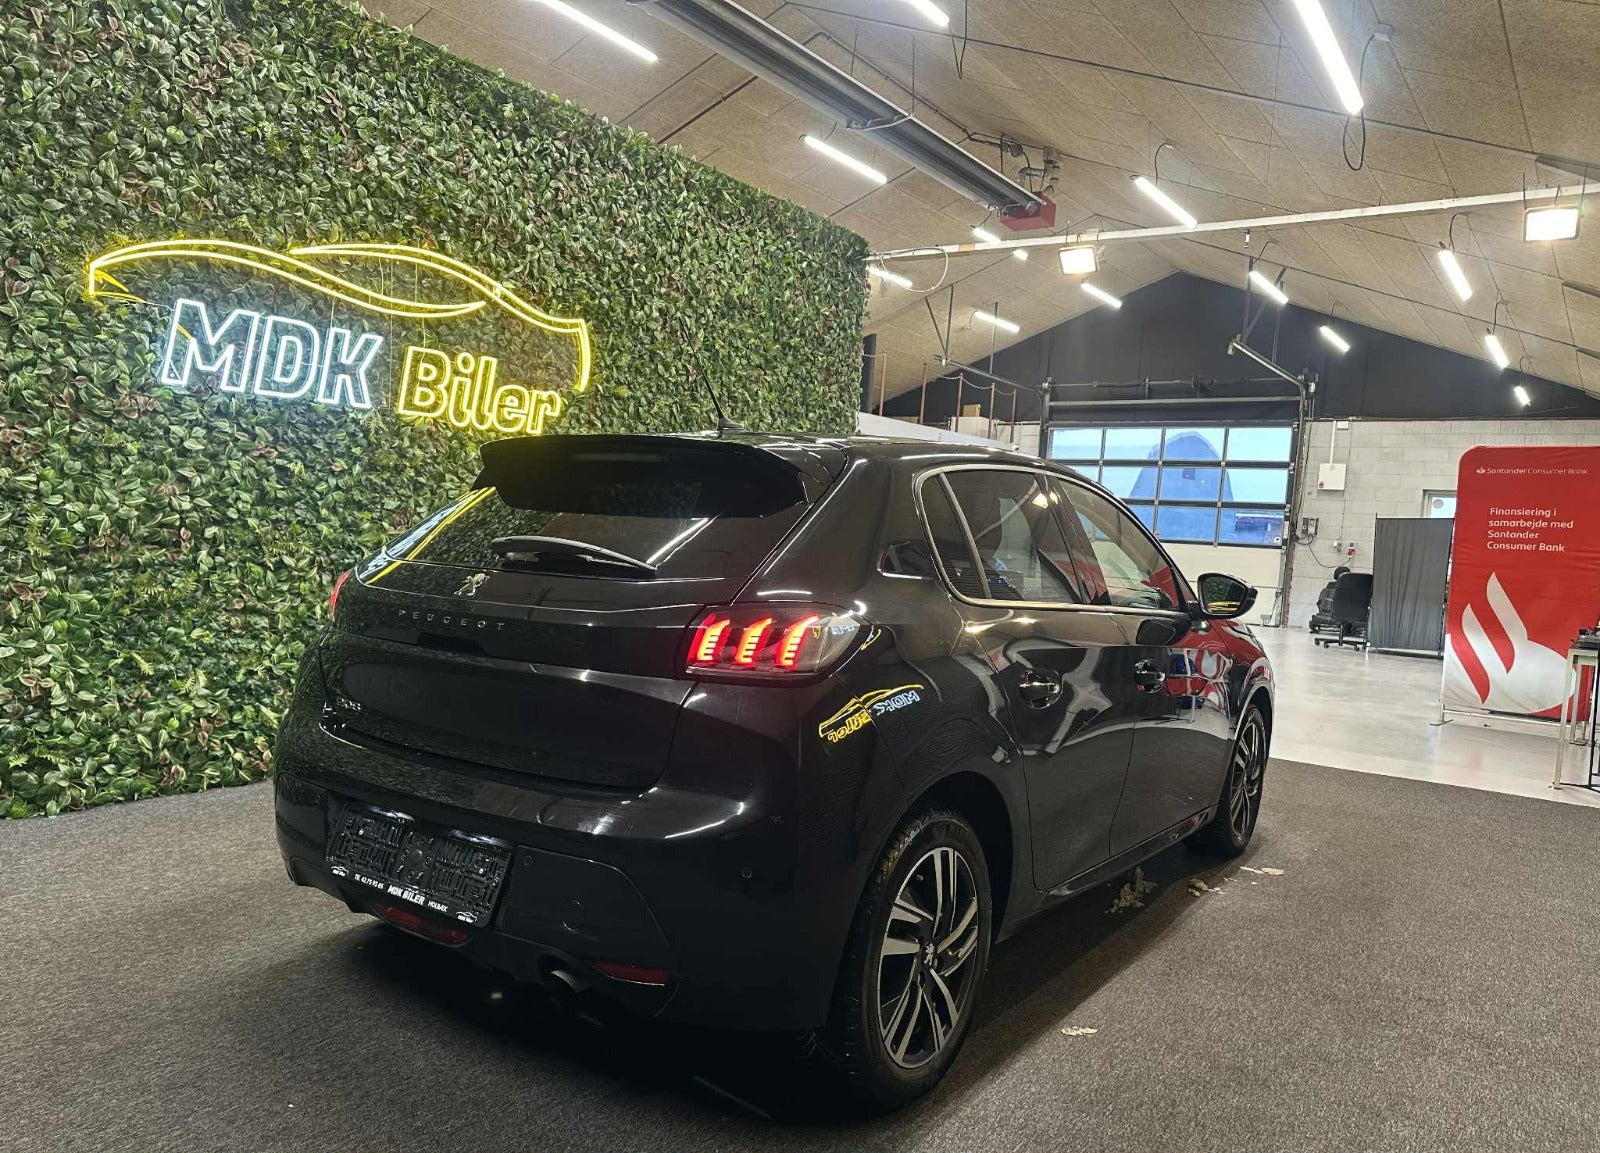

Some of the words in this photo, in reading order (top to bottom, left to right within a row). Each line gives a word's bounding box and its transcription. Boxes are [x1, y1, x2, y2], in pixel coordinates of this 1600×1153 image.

[160, 298, 384, 411] MDK
[397, 345, 562, 435] Biler
[1527, 467, 1567, 475] Consumer
[1490, 507, 1551, 517] Finansiering
[1488, 519, 1548, 529] samarbejde
[1550, 520, 1574, 529] med
[1488, 530, 1540, 539] Santander
[1487, 541, 1537, 550] Consumer
[1539, 542, 1566, 552] Bank
[398, 610, 505, 630] PEUGEOT
[387, 885, 404, 898] MDK
[401, 890, 426, 906] BILER
